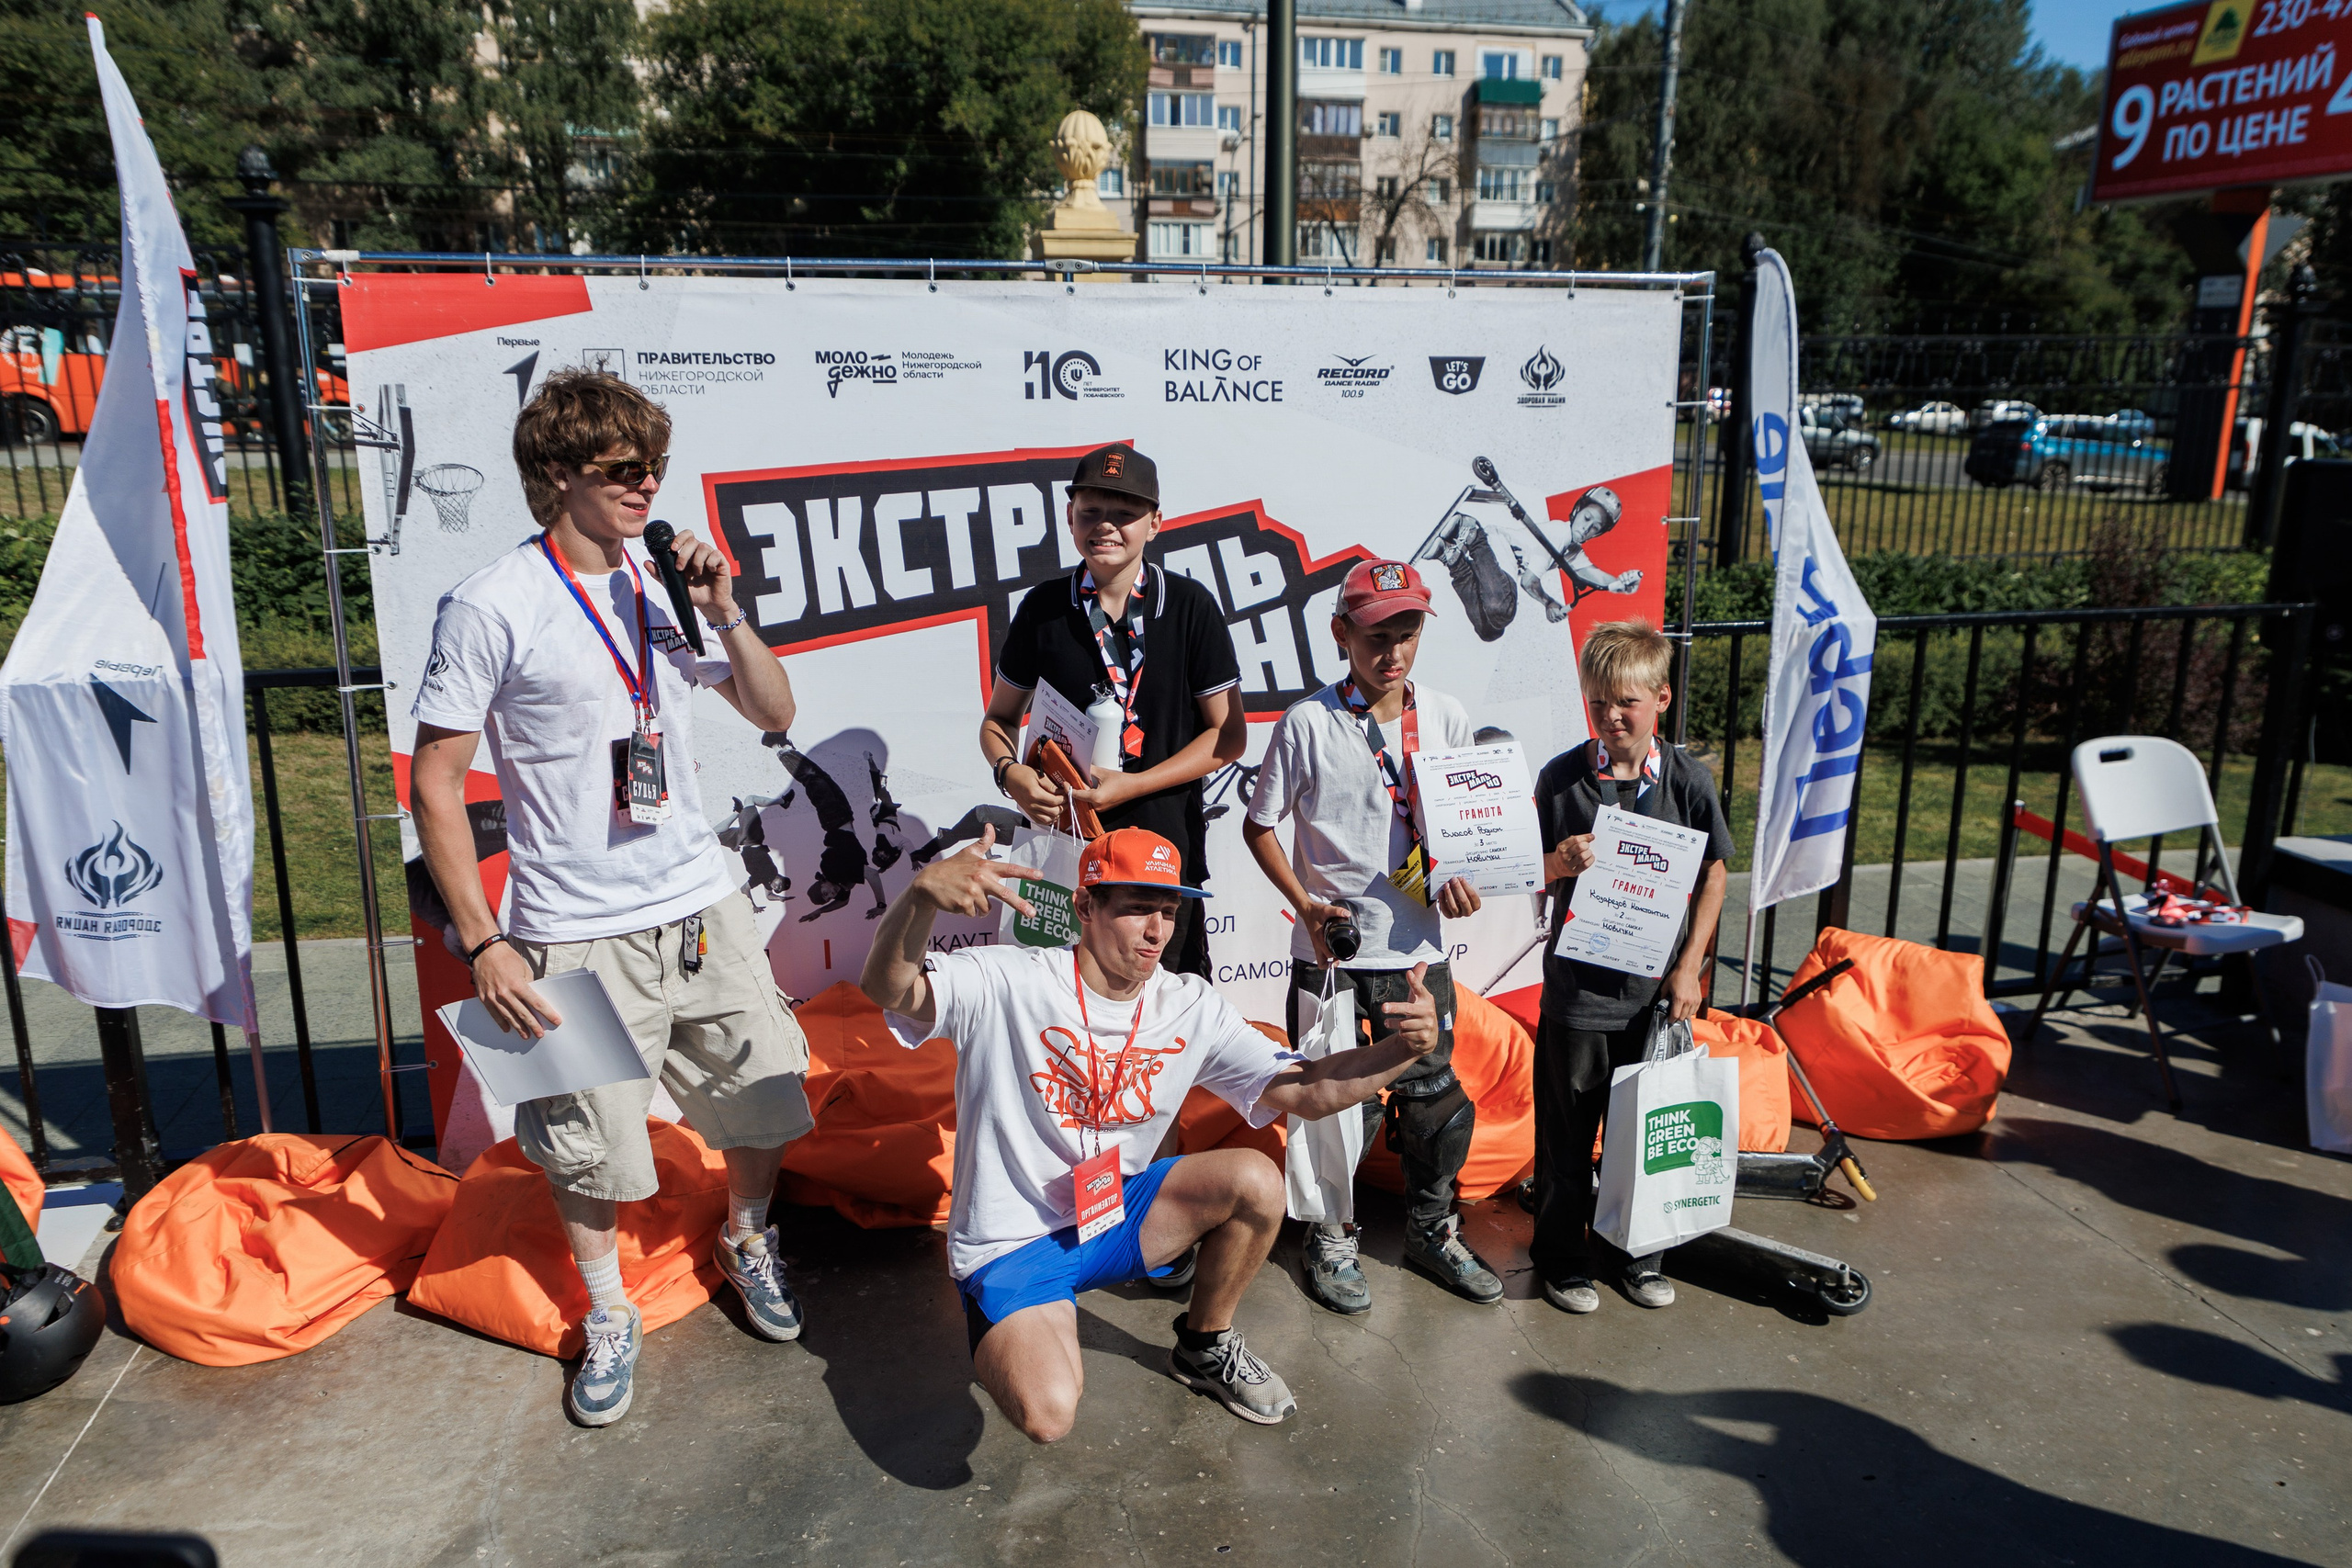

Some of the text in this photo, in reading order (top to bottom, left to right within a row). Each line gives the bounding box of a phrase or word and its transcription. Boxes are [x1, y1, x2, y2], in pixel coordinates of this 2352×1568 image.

[2112, 84, 2154, 171] 9
[2159, 41, 2335, 118] РАСТЕНИЙ
[2163, 104, 2312, 163] ПО ЦЕНЕ
[497, 336, 540, 348] Первые
[637, 352, 775, 365] ПРАВИТЕЛЬСТВО
[901, 351, 955, 361] Молодежь
[1164, 348, 1261, 371] KING OF
[902, 360, 982, 370] Нижегородской
[1317, 368, 1390, 378] RECORD
[639, 368, 763, 383] НИЖЕГОРОДСКОЙ
[903, 370, 944, 378] области
[1442, 372, 1472, 390] GO
[640, 384, 705, 395] ОБЛАСТИ
[648, 628, 675, 641] КСТРЕ
[1448, 772, 1476, 785] ЭКСТРЕ
[632, 781, 657, 800] СУДЬЯ
[1459, 806, 1503, 820] ГРАМОТА
[1619, 842, 1649, 855] ЭКСТРЕ
[1653, 860, 1668, 872] НО
[1025, 883, 1069, 909] THINK
[1612, 878, 1656, 899] ГРАМОТА
[1020, 915, 1072, 942] BE ECO
[1218, 959, 1293, 983] САМОК
[1647, 1109, 1691, 1132] THINK
[1647, 1122, 1696, 1145] GREEN
[1647, 1138, 1700, 1161] BE ECO
[1080, 1192, 1118, 1221] ОРГАНИЗАТОР
[1674, 1195, 1721, 1211] SYNERGETIC
